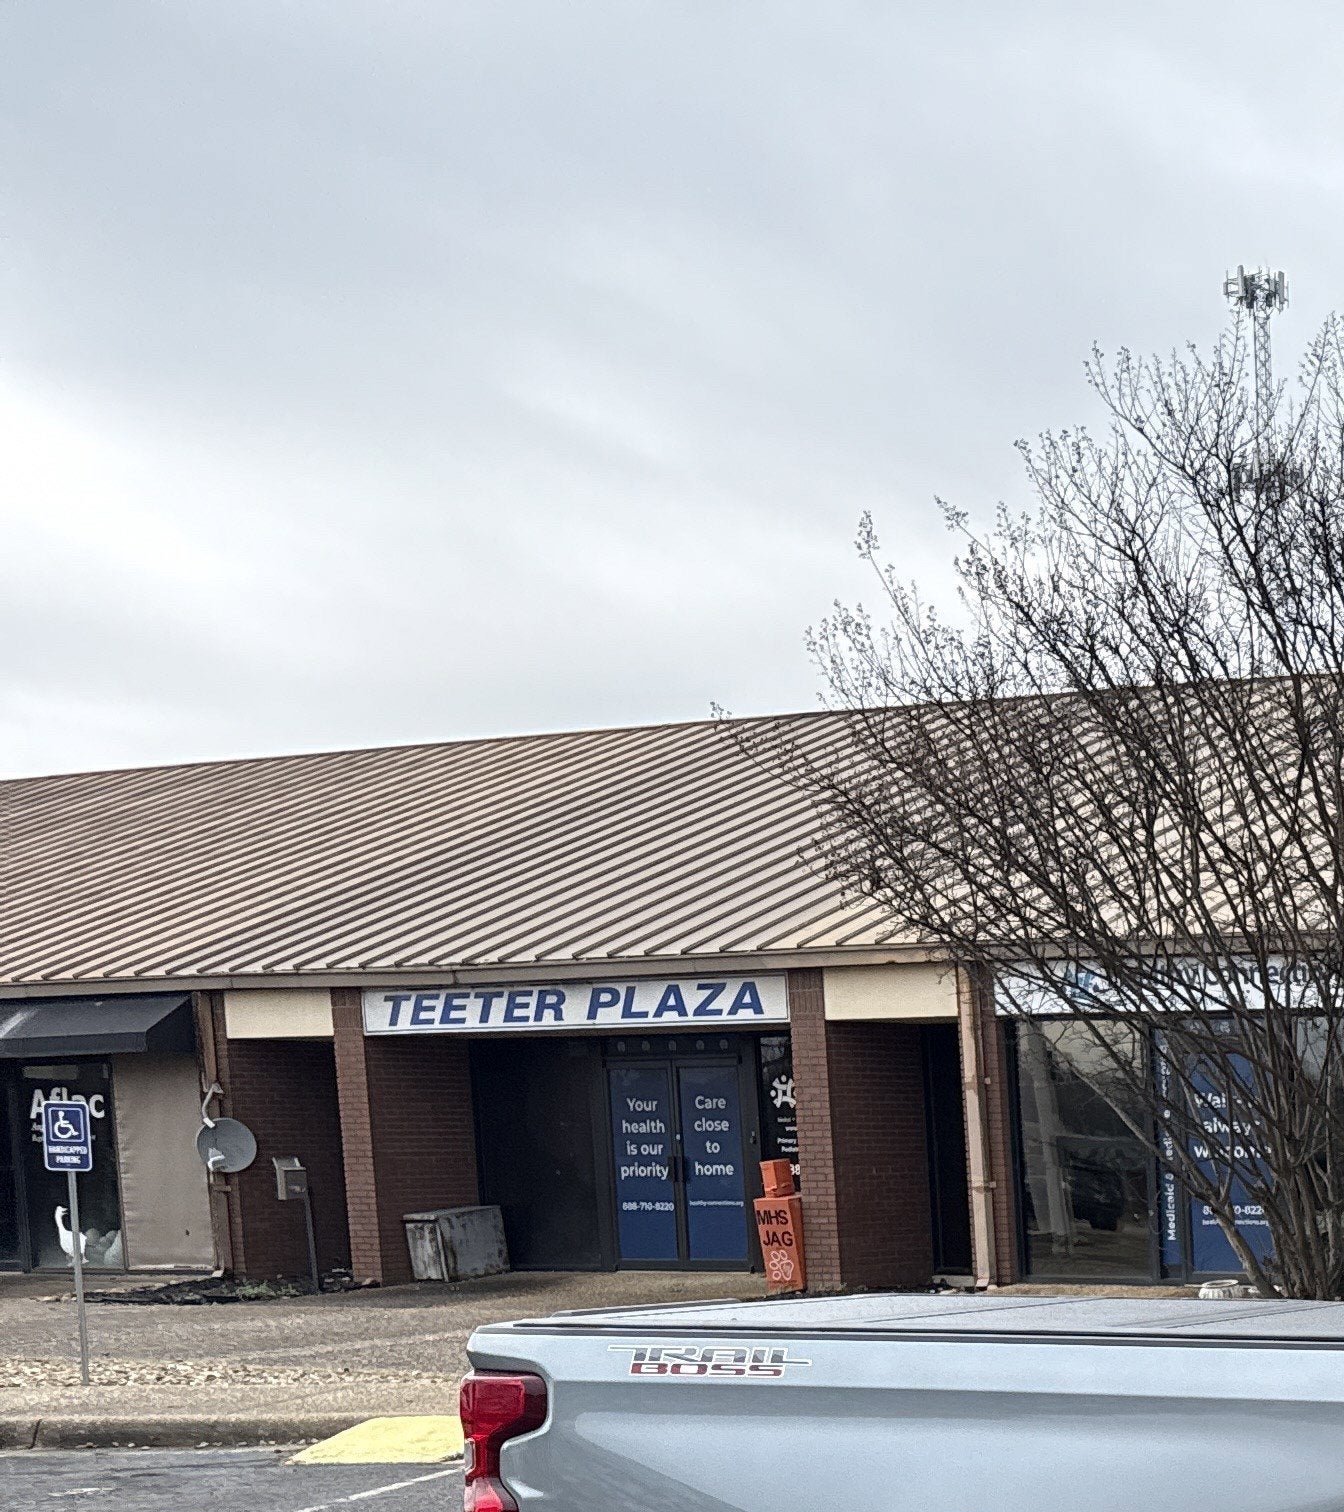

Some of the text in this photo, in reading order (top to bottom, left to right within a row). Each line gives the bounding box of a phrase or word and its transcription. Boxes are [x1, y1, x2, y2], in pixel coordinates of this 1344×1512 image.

[384, 981, 764, 1027] TEETER PLAZA
[30, 1086, 105, 1119] Aflc
[626, 1097, 658, 1112] Your
[694, 1095, 727, 1110] Care
[621, 1119, 666, 1134] health
[694, 1117, 730, 1132] close
[1203, 1117, 1261, 1136] alway
[626, 1140, 664, 1155] is our
[705, 1140, 721, 1154] to
[620, 1162, 669, 1181] priority
[694, 1161, 735, 1176] home
[756, 1209, 789, 1226] MHS
[763, 1230, 794, 1247] JAG
[607, 1344, 813, 1367] TRAIL
[629, 1362, 785, 1379] BOSS
